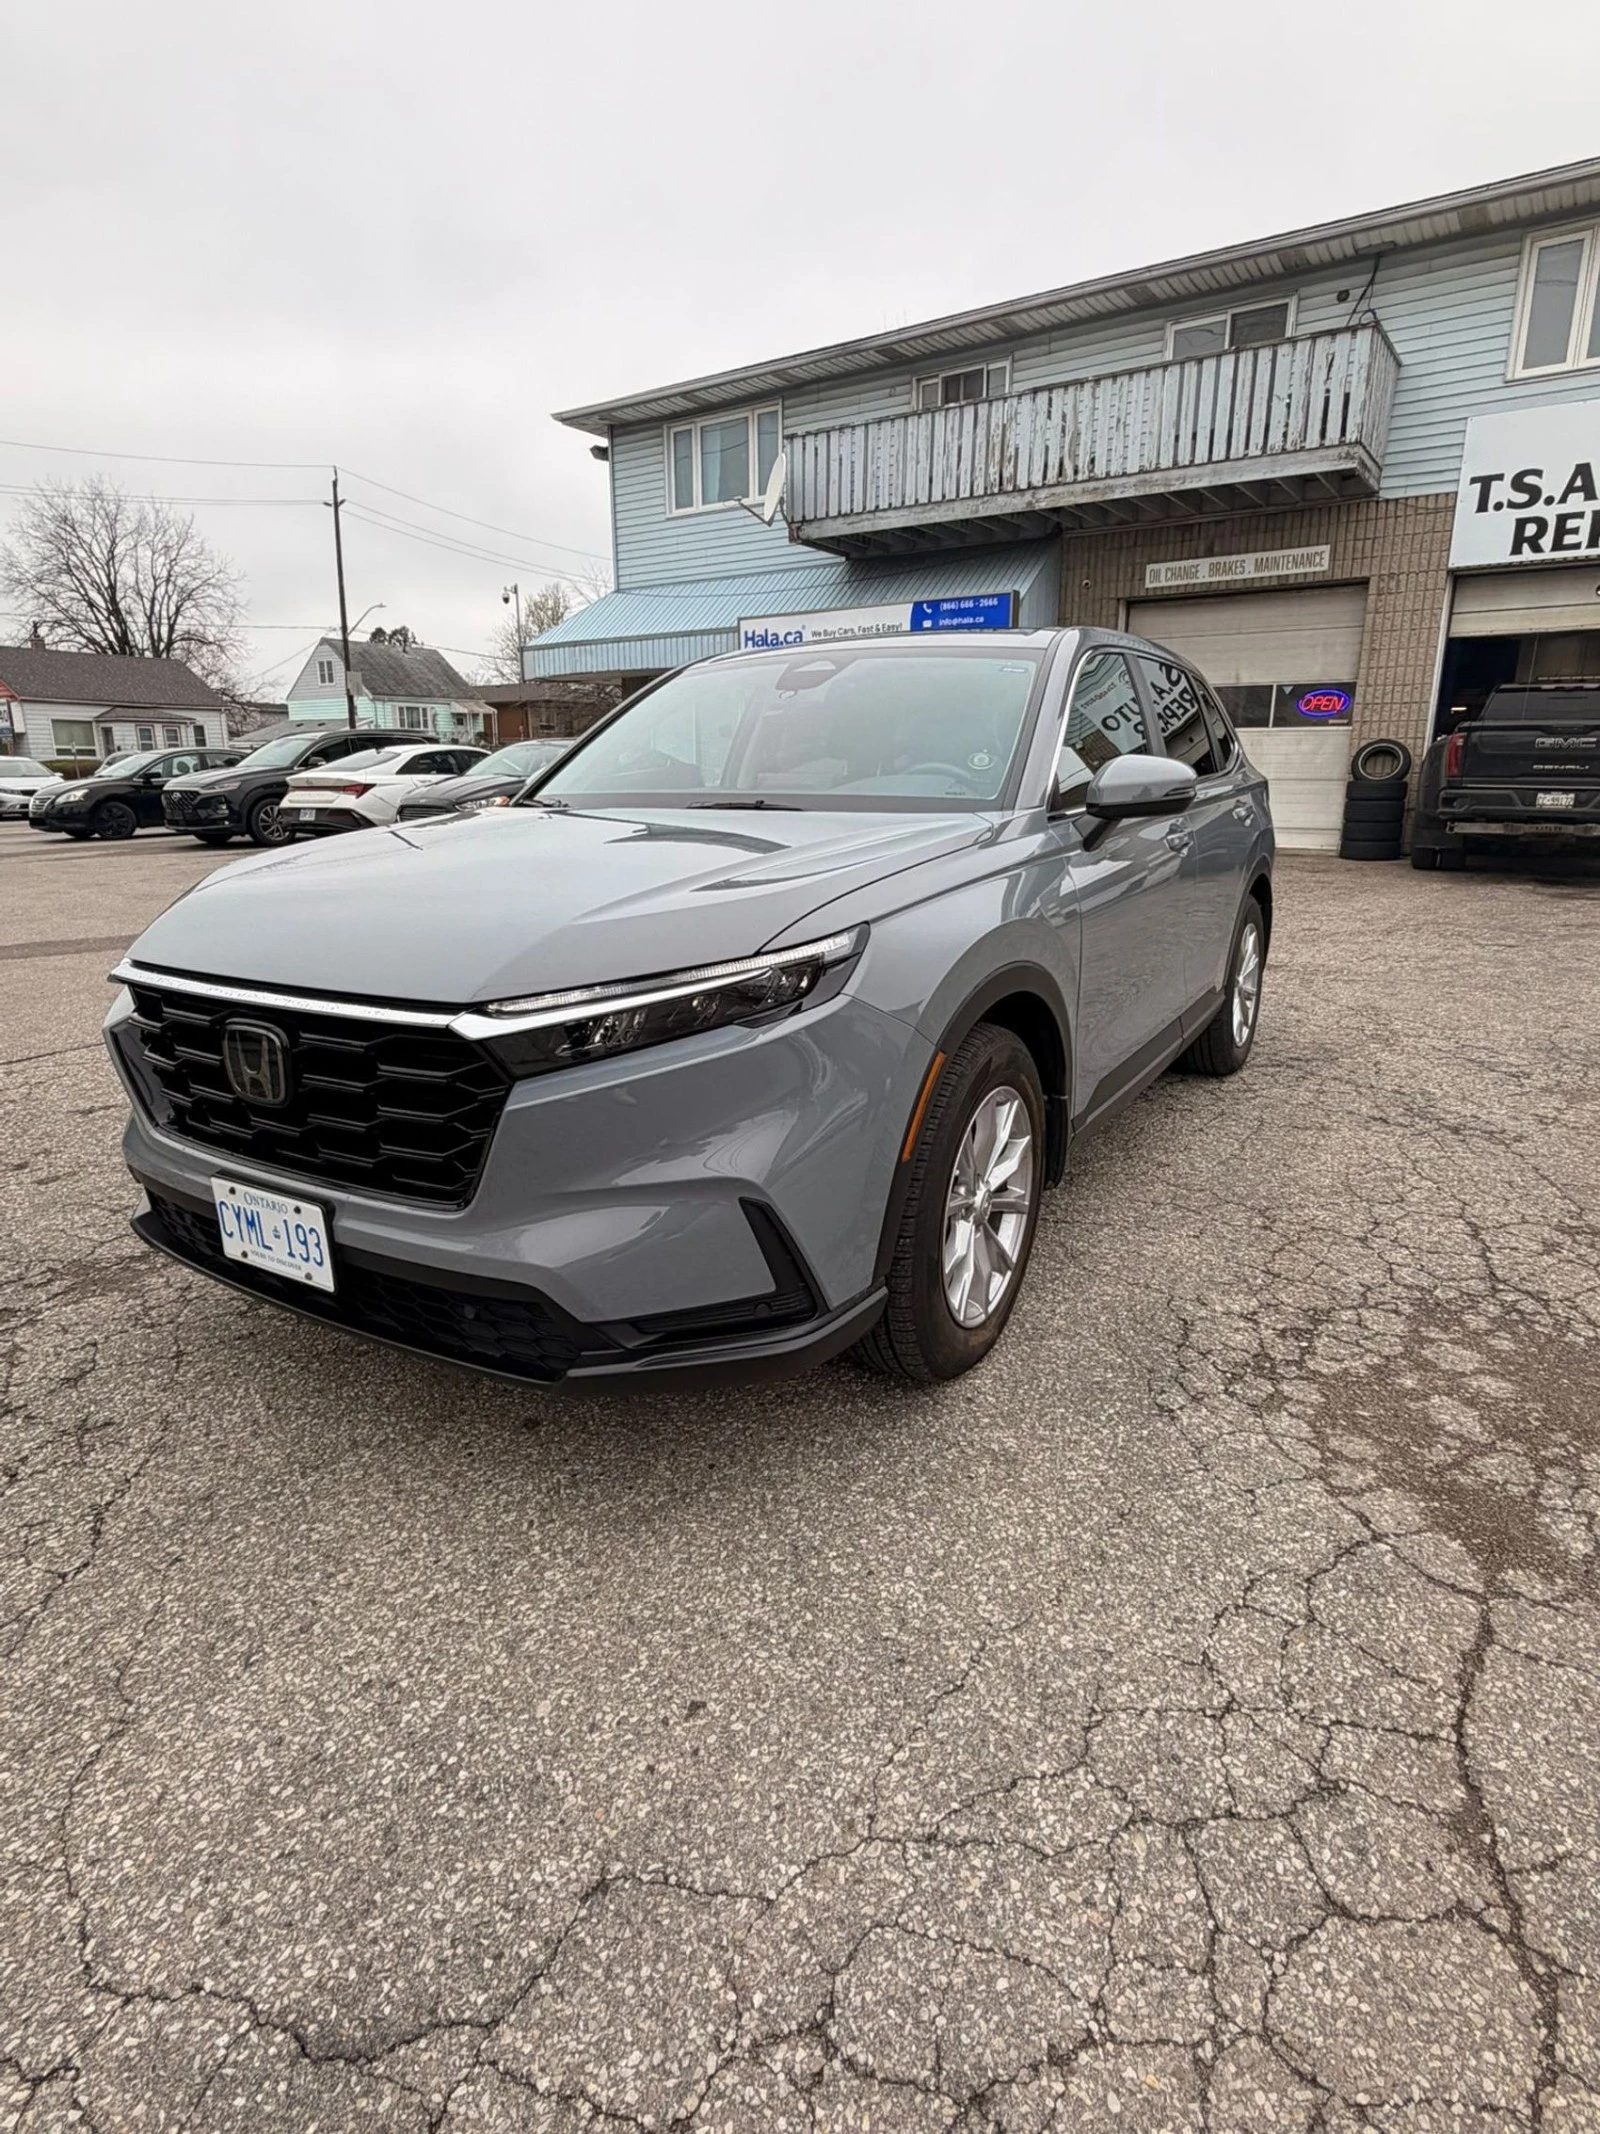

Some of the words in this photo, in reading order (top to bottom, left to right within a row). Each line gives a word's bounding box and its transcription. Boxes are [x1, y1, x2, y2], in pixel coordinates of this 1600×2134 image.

[1149, 567, 1162, 584] OIL
[1164, 564, 1201, 582] CHANGE
[1208, 559, 1246, 578] BRAKES
[1254, 550, 1326, 574] MAINTENANCE
[744, 628, 804, 649] Hala.ca
[811, 630, 822, 638] We
[823, 628, 837, 639] Buy
[837, 627, 856, 637] Cars,
[858, 625, 874, 634] Fast
[875, 623, 881, 632] &
[882, 621, 903, 633] Easy!
[1302, 695, 1345, 711] OPEN
[1535, 737, 1597, 748] GMC
[243, 1192, 288, 1214] ONTARIO
[219, 1200, 273, 1251] CYML
[283, 1219, 324, 1267] 193
